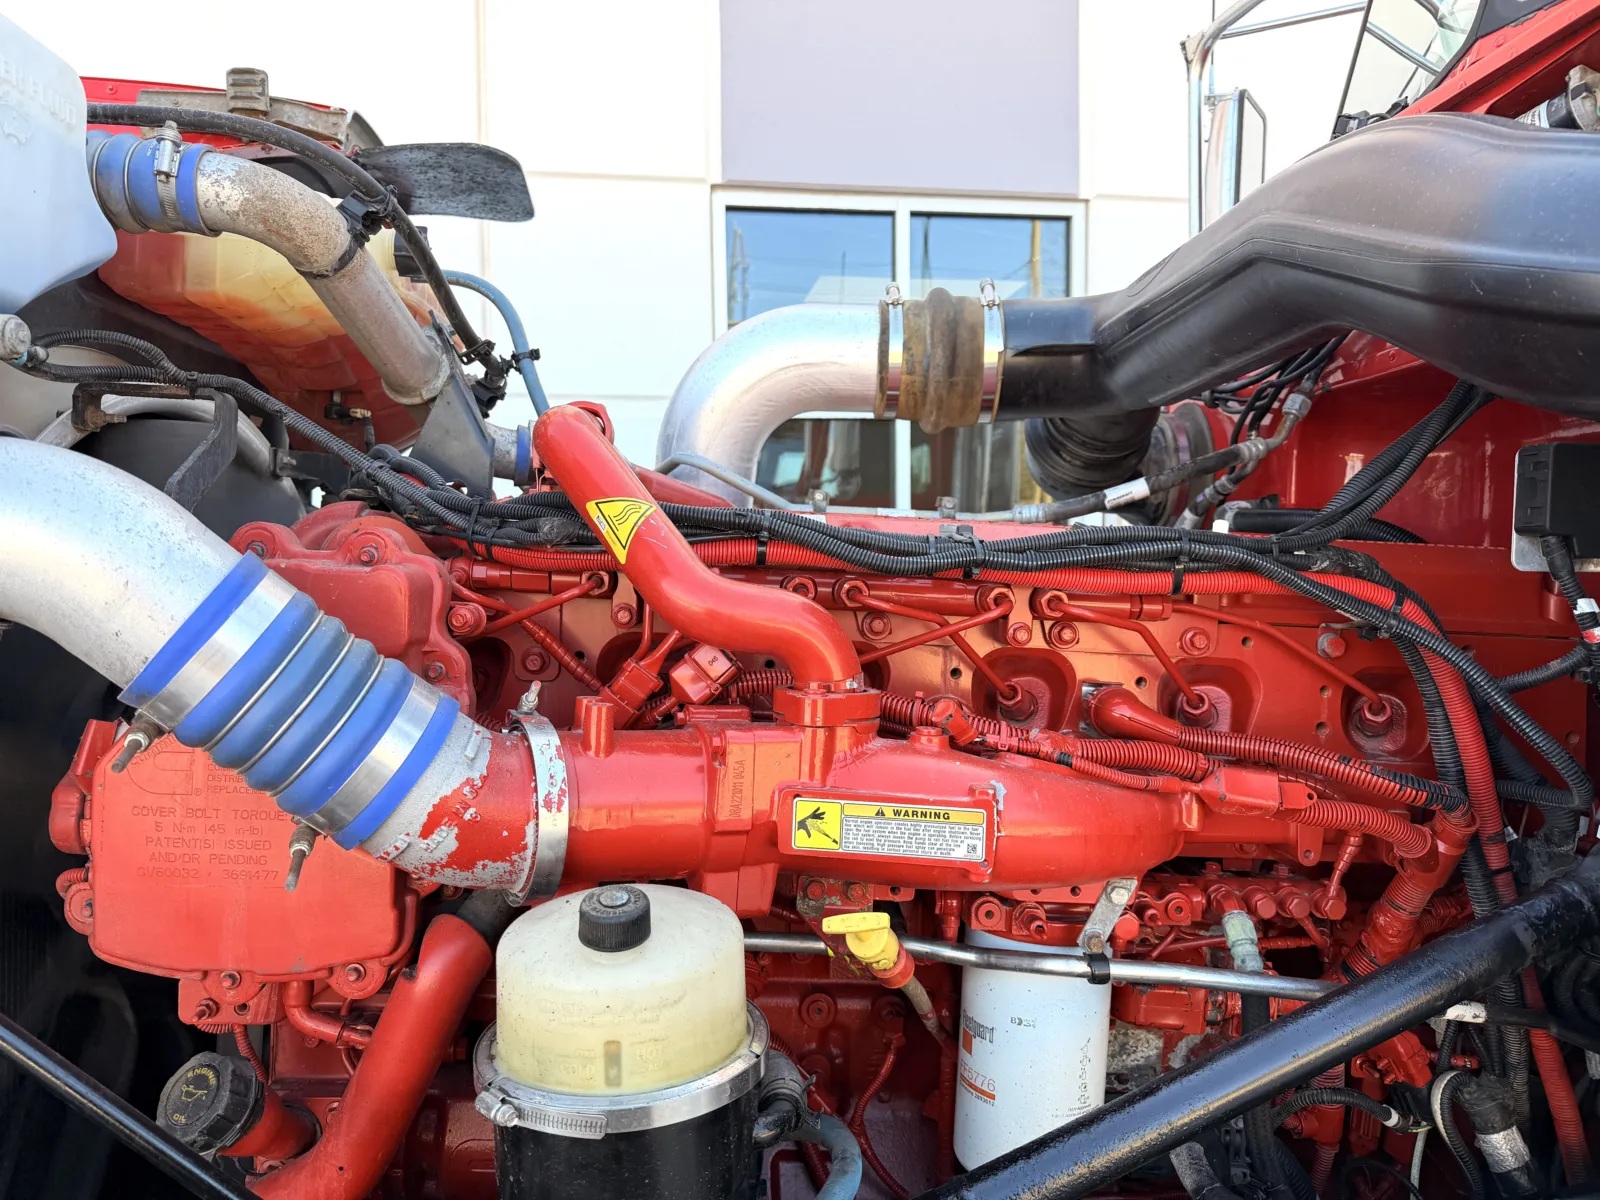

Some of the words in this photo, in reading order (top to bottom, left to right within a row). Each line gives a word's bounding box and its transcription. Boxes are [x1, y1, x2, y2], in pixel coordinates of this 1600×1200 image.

[132, 805, 177, 818] COVER
[185, 807, 222, 819] BOLT
[892, 808, 951, 820] WARNING
[155, 821, 163, 832] 5
[204, 823, 226, 835] (45
[235, 825, 264, 836] in-lb)
[145, 836, 215, 850] PATENT(S)
[224, 838, 272, 851] ISSUED
[149, 851, 201, 864] AND/OR
[209, 853, 268, 866] PENDING
[636, 1047, 662, 1060] HOT
[187, 1067, 216, 1086] ENGINE
[172, 1113, 187, 1124] OIL
